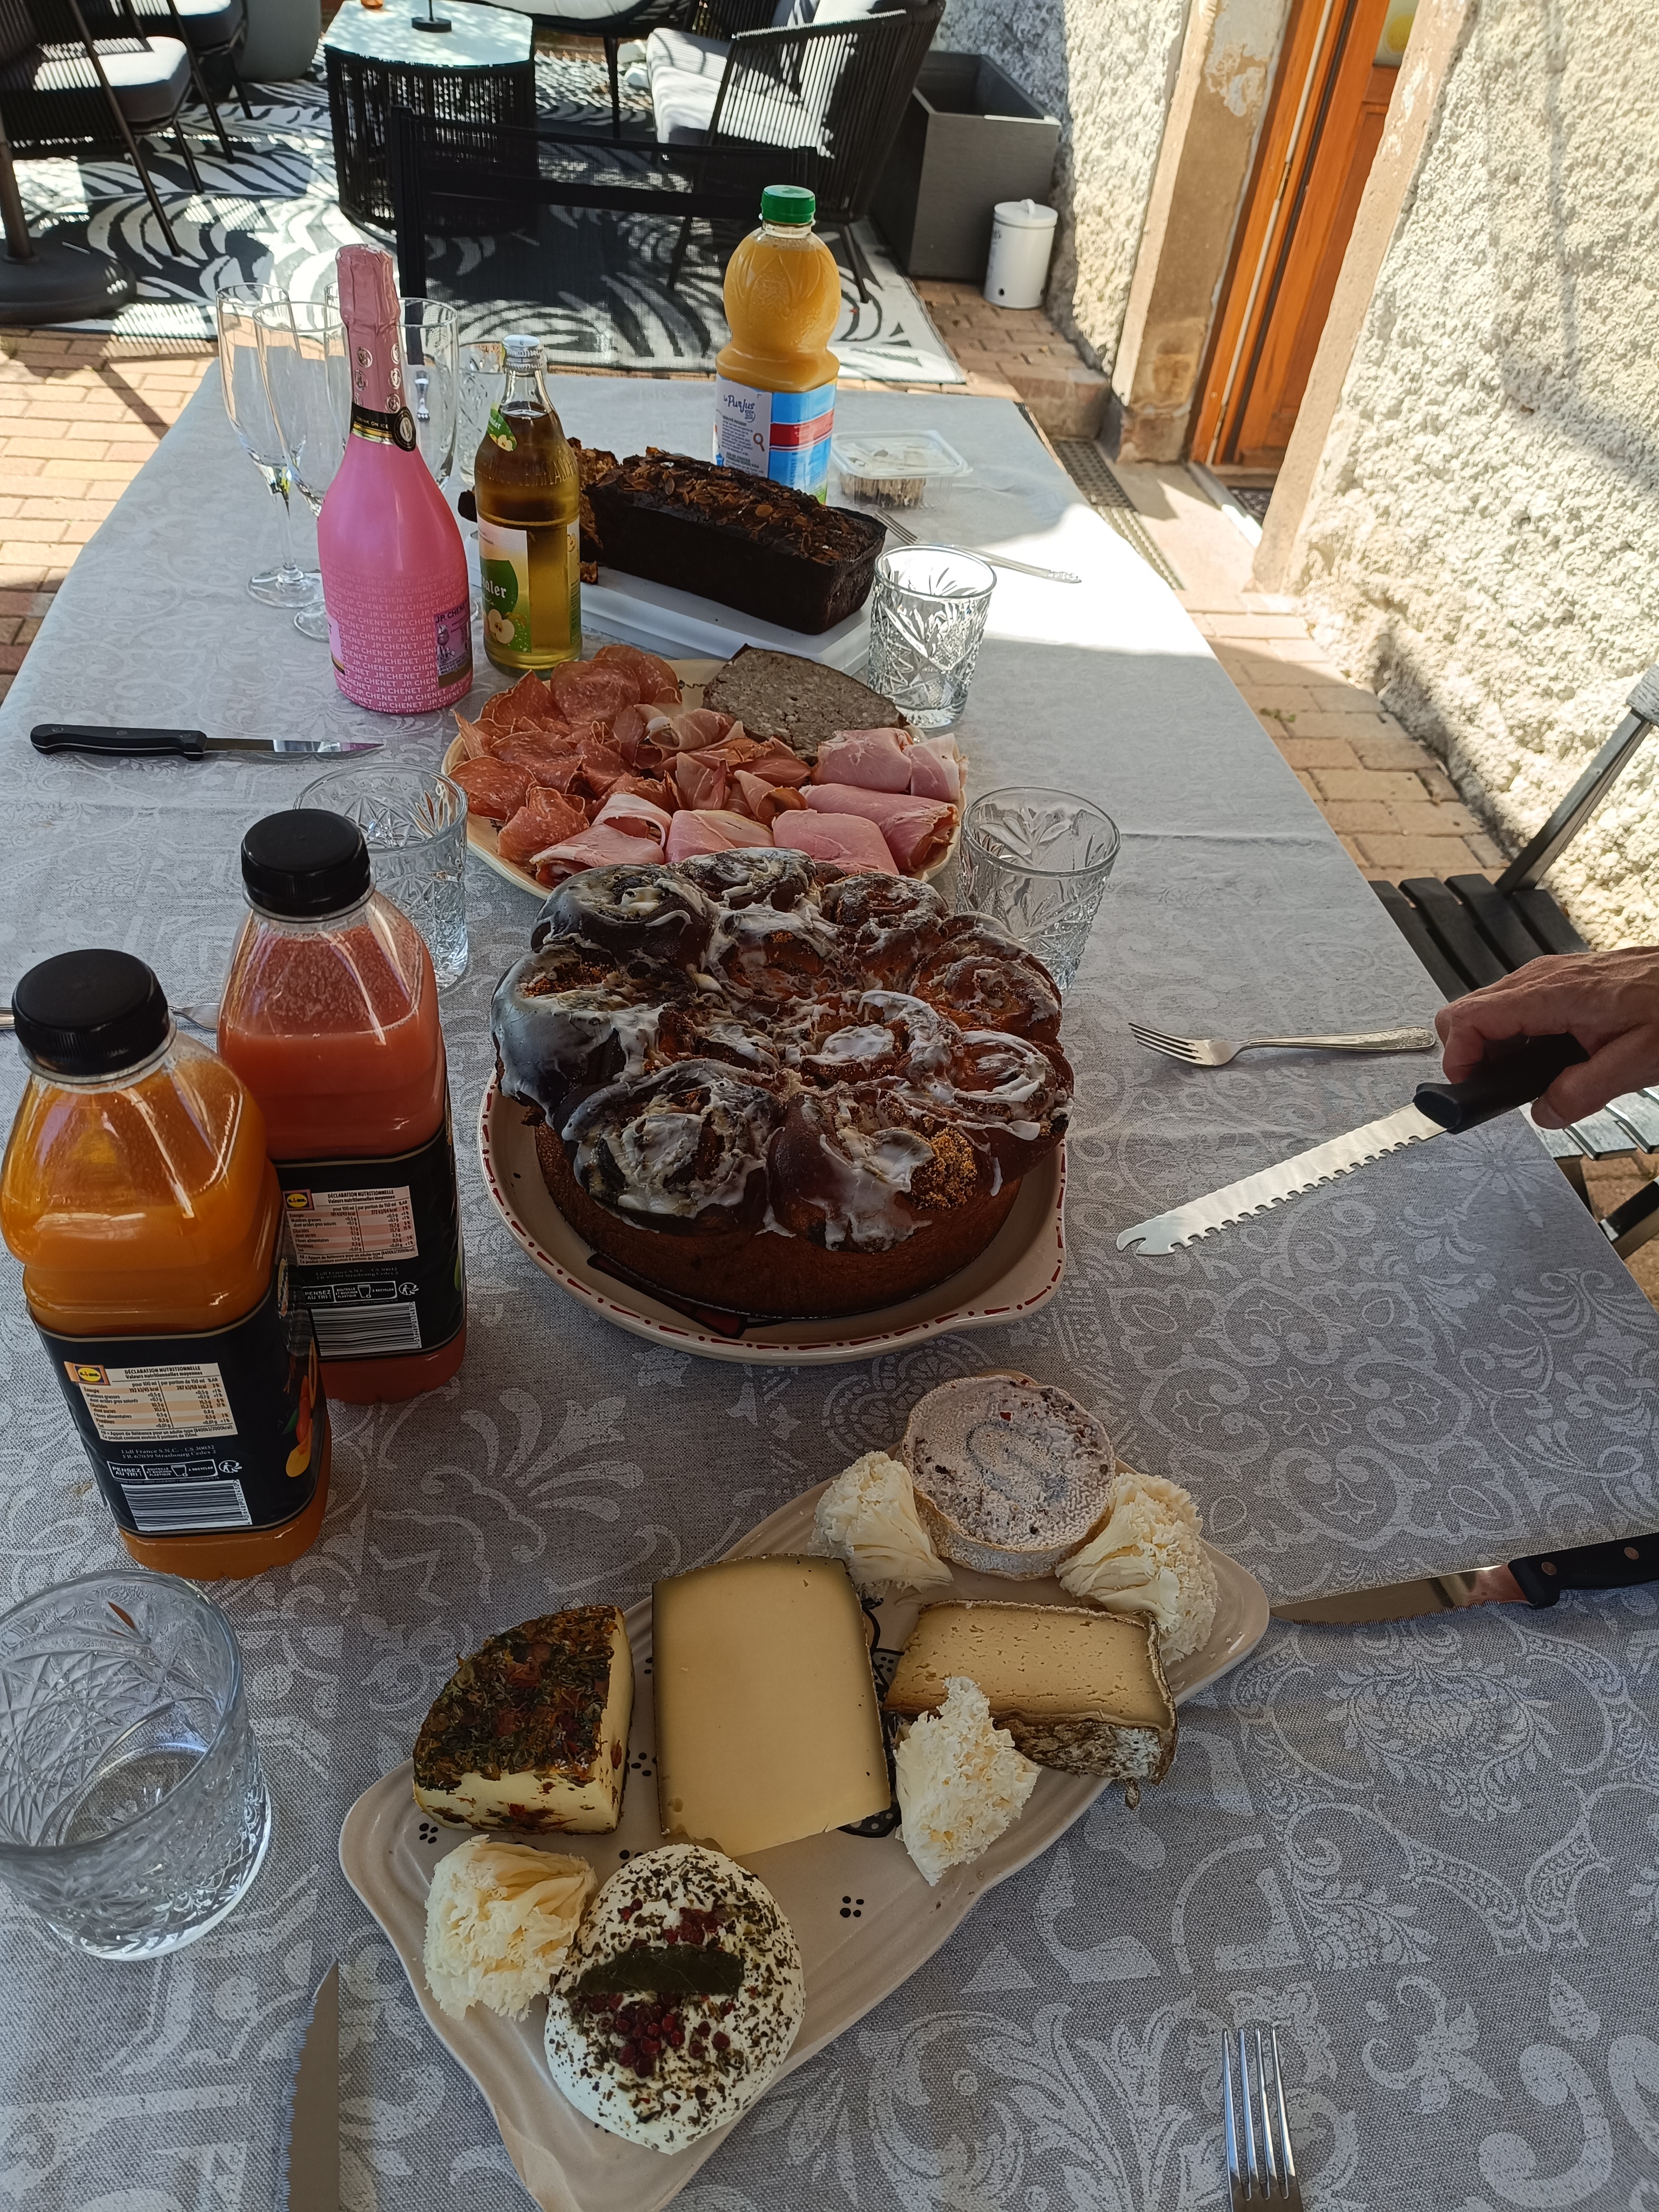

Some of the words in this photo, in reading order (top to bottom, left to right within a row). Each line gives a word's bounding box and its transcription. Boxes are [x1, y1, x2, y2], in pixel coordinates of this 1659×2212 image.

[335, 601, 363, 615] CHENET
[432, 599, 456, 614] CHENET
[356, 602, 389, 611] CHENET
[407, 599, 439, 610] CHENET
[447, 601, 467, 619] CHENET
[338, 617, 365, 631] CHENET
[358, 617, 390, 626] CHENET
[340, 632, 367, 646] CHENET
[360, 632, 392, 642] CHENET
[342, 647, 368, 662] CHENET
[361, 648, 393, 657] CHENET
[343, 662, 369, 676] CHENET
[362, 662, 395, 672] CHENET
[345, 676, 371, 691] CHENET
[364, 677, 396, 687] CHENET
[347, 691, 372, 705] CHENET
[439, 687, 463, 704] CHENET
[365, 692, 398, 701] CHENET
[416, 688, 447, 700] CHENET
